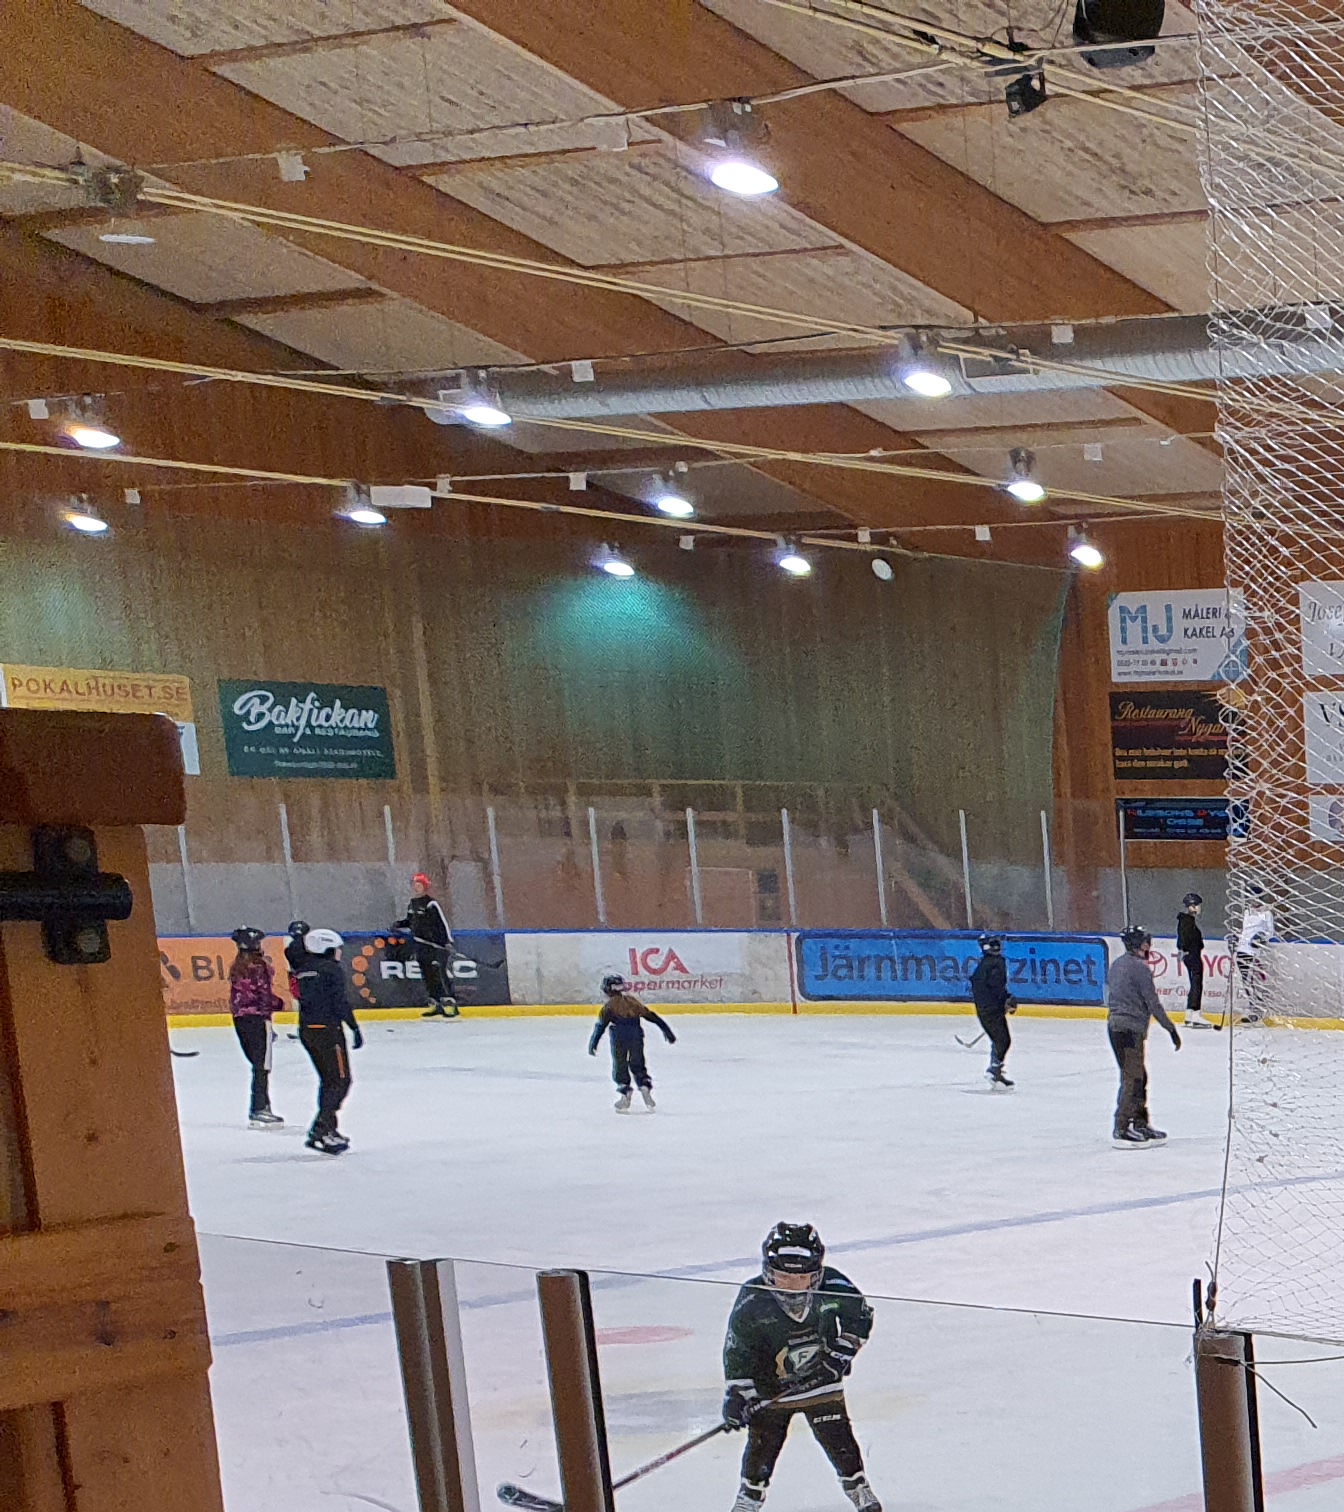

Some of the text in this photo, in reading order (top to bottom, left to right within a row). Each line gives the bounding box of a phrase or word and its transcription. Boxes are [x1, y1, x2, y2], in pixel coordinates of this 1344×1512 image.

[1119, 604, 1173, 645] MJ
[1182, 604, 1221, 620] MÅLERI
[1183, 626, 1217, 639] KAKEL
[11, 676, 188, 700] POKALHUSET.SE
[233, 690, 379, 742] Bakfickan
[380, 961, 478, 979] REC
[629, 947, 689, 976] ICA
[814, 944, 1098, 986] Järnmazinet
